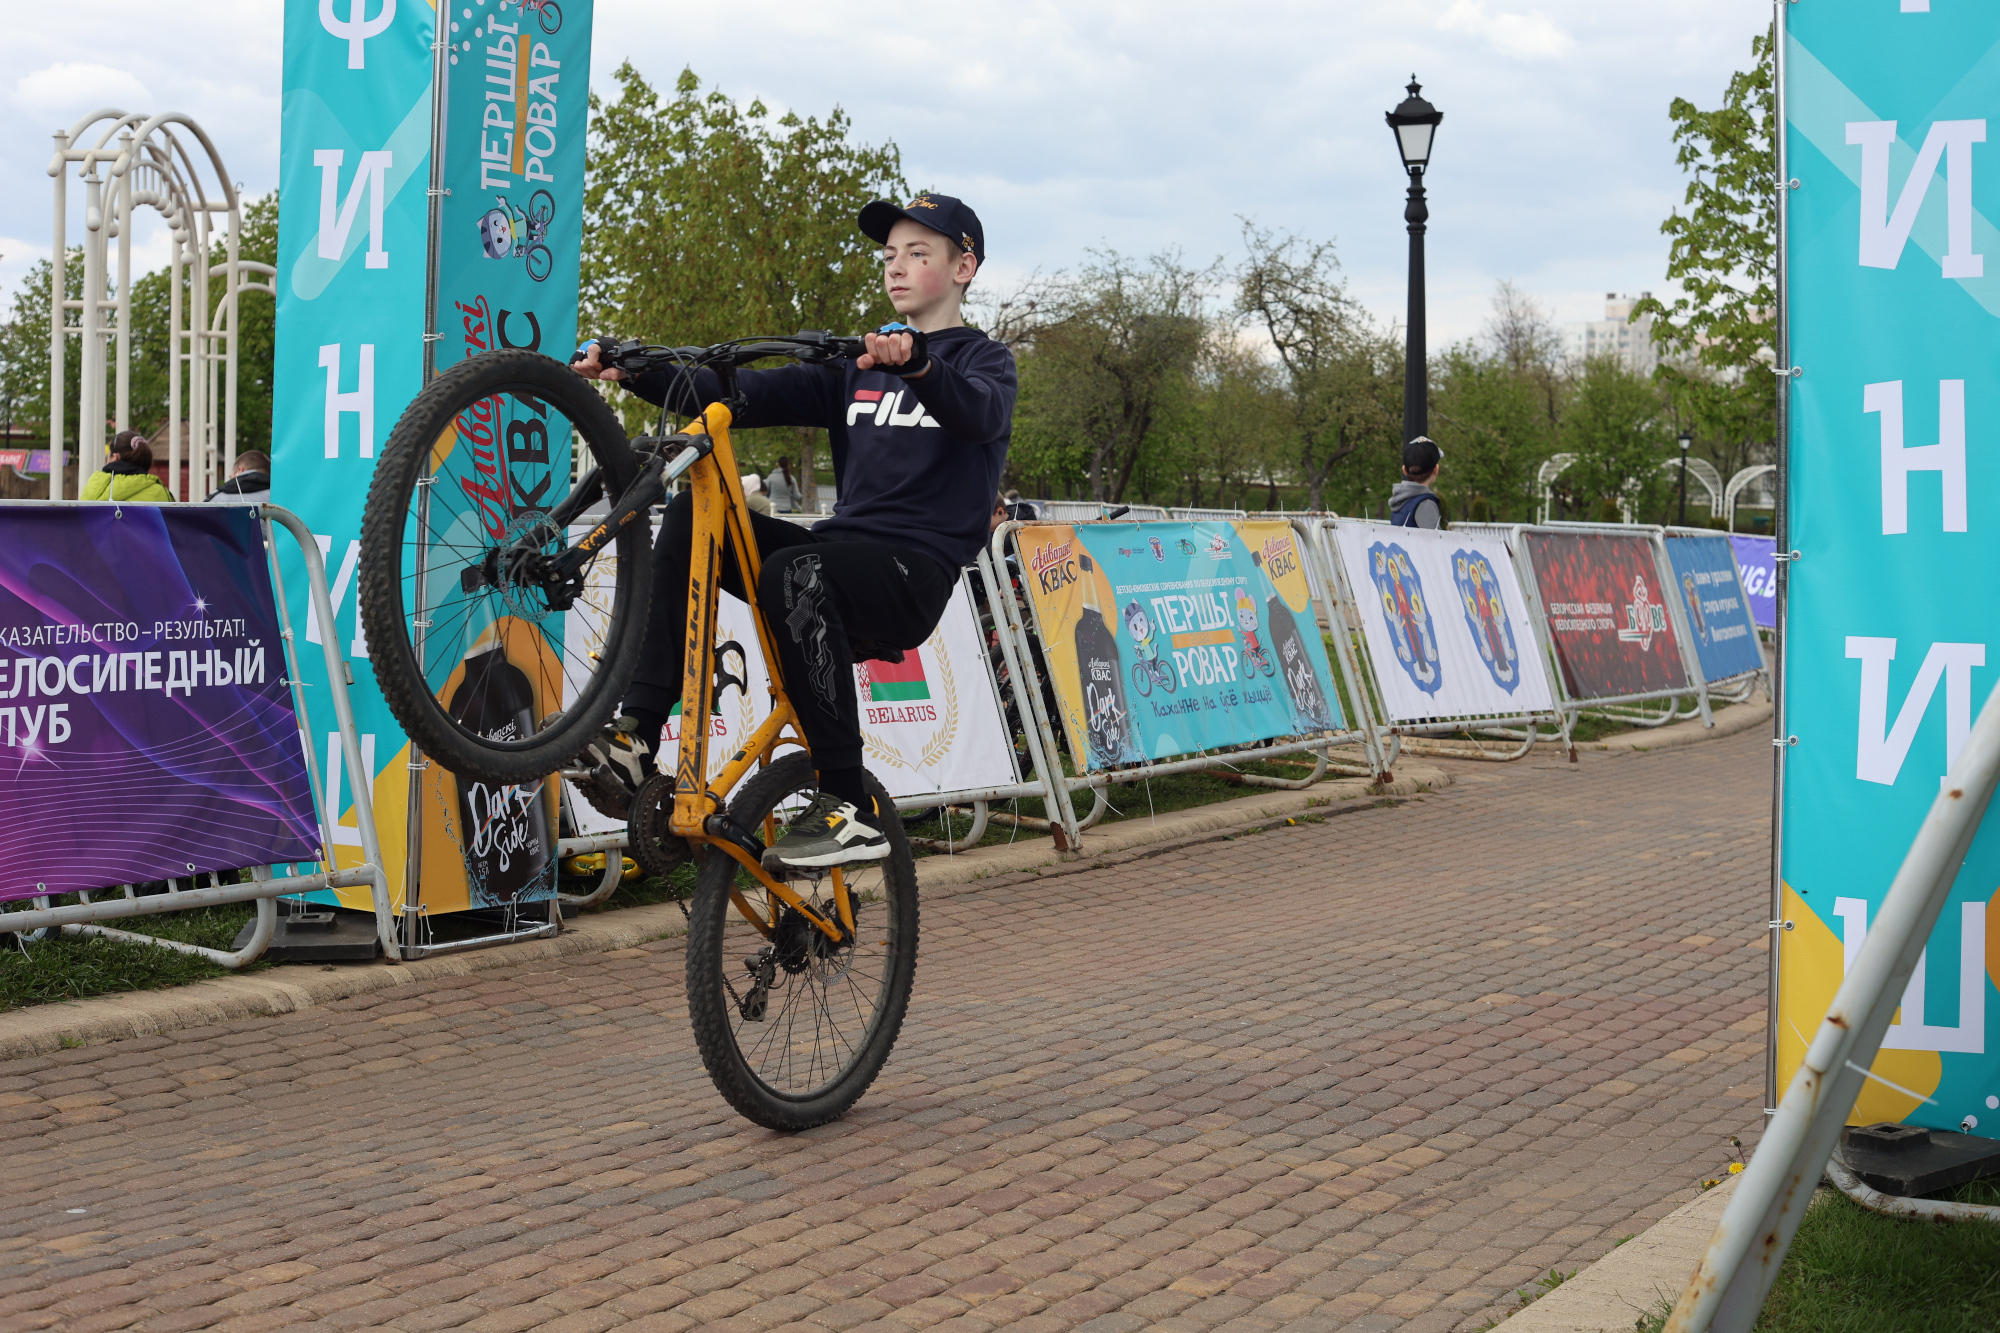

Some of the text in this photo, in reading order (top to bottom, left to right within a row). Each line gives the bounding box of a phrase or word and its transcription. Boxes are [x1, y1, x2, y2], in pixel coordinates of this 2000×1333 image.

[481, 22, 519, 190] ПЕРШЫ
[516, 85, 527, 135] 2024
[525, 42, 561, 183] РОВАР
[1833, 0, 1987, 1054] ИНИШ
[1038, 560, 1077, 596] КВАС
[1268, 551, 1296, 580] КВАС
[154, 618, 246, 641] РЕЗУЛЬТАТ!
[687, 577, 700, 679] FUJI
[1150, 591, 1235, 635] ПЕРШЫ
[1091, 668, 1112, 681] КВАС
[1172, 645, 1238, 688] РОВАР
[866, 705, 937, 725] BELARUS
[1086, 682, 1123, 733] Dark
[1151, 698, 1200, 717] Каханне
[1203, 696, 1217, 710] на
[494, 816, 529, 873] Side
